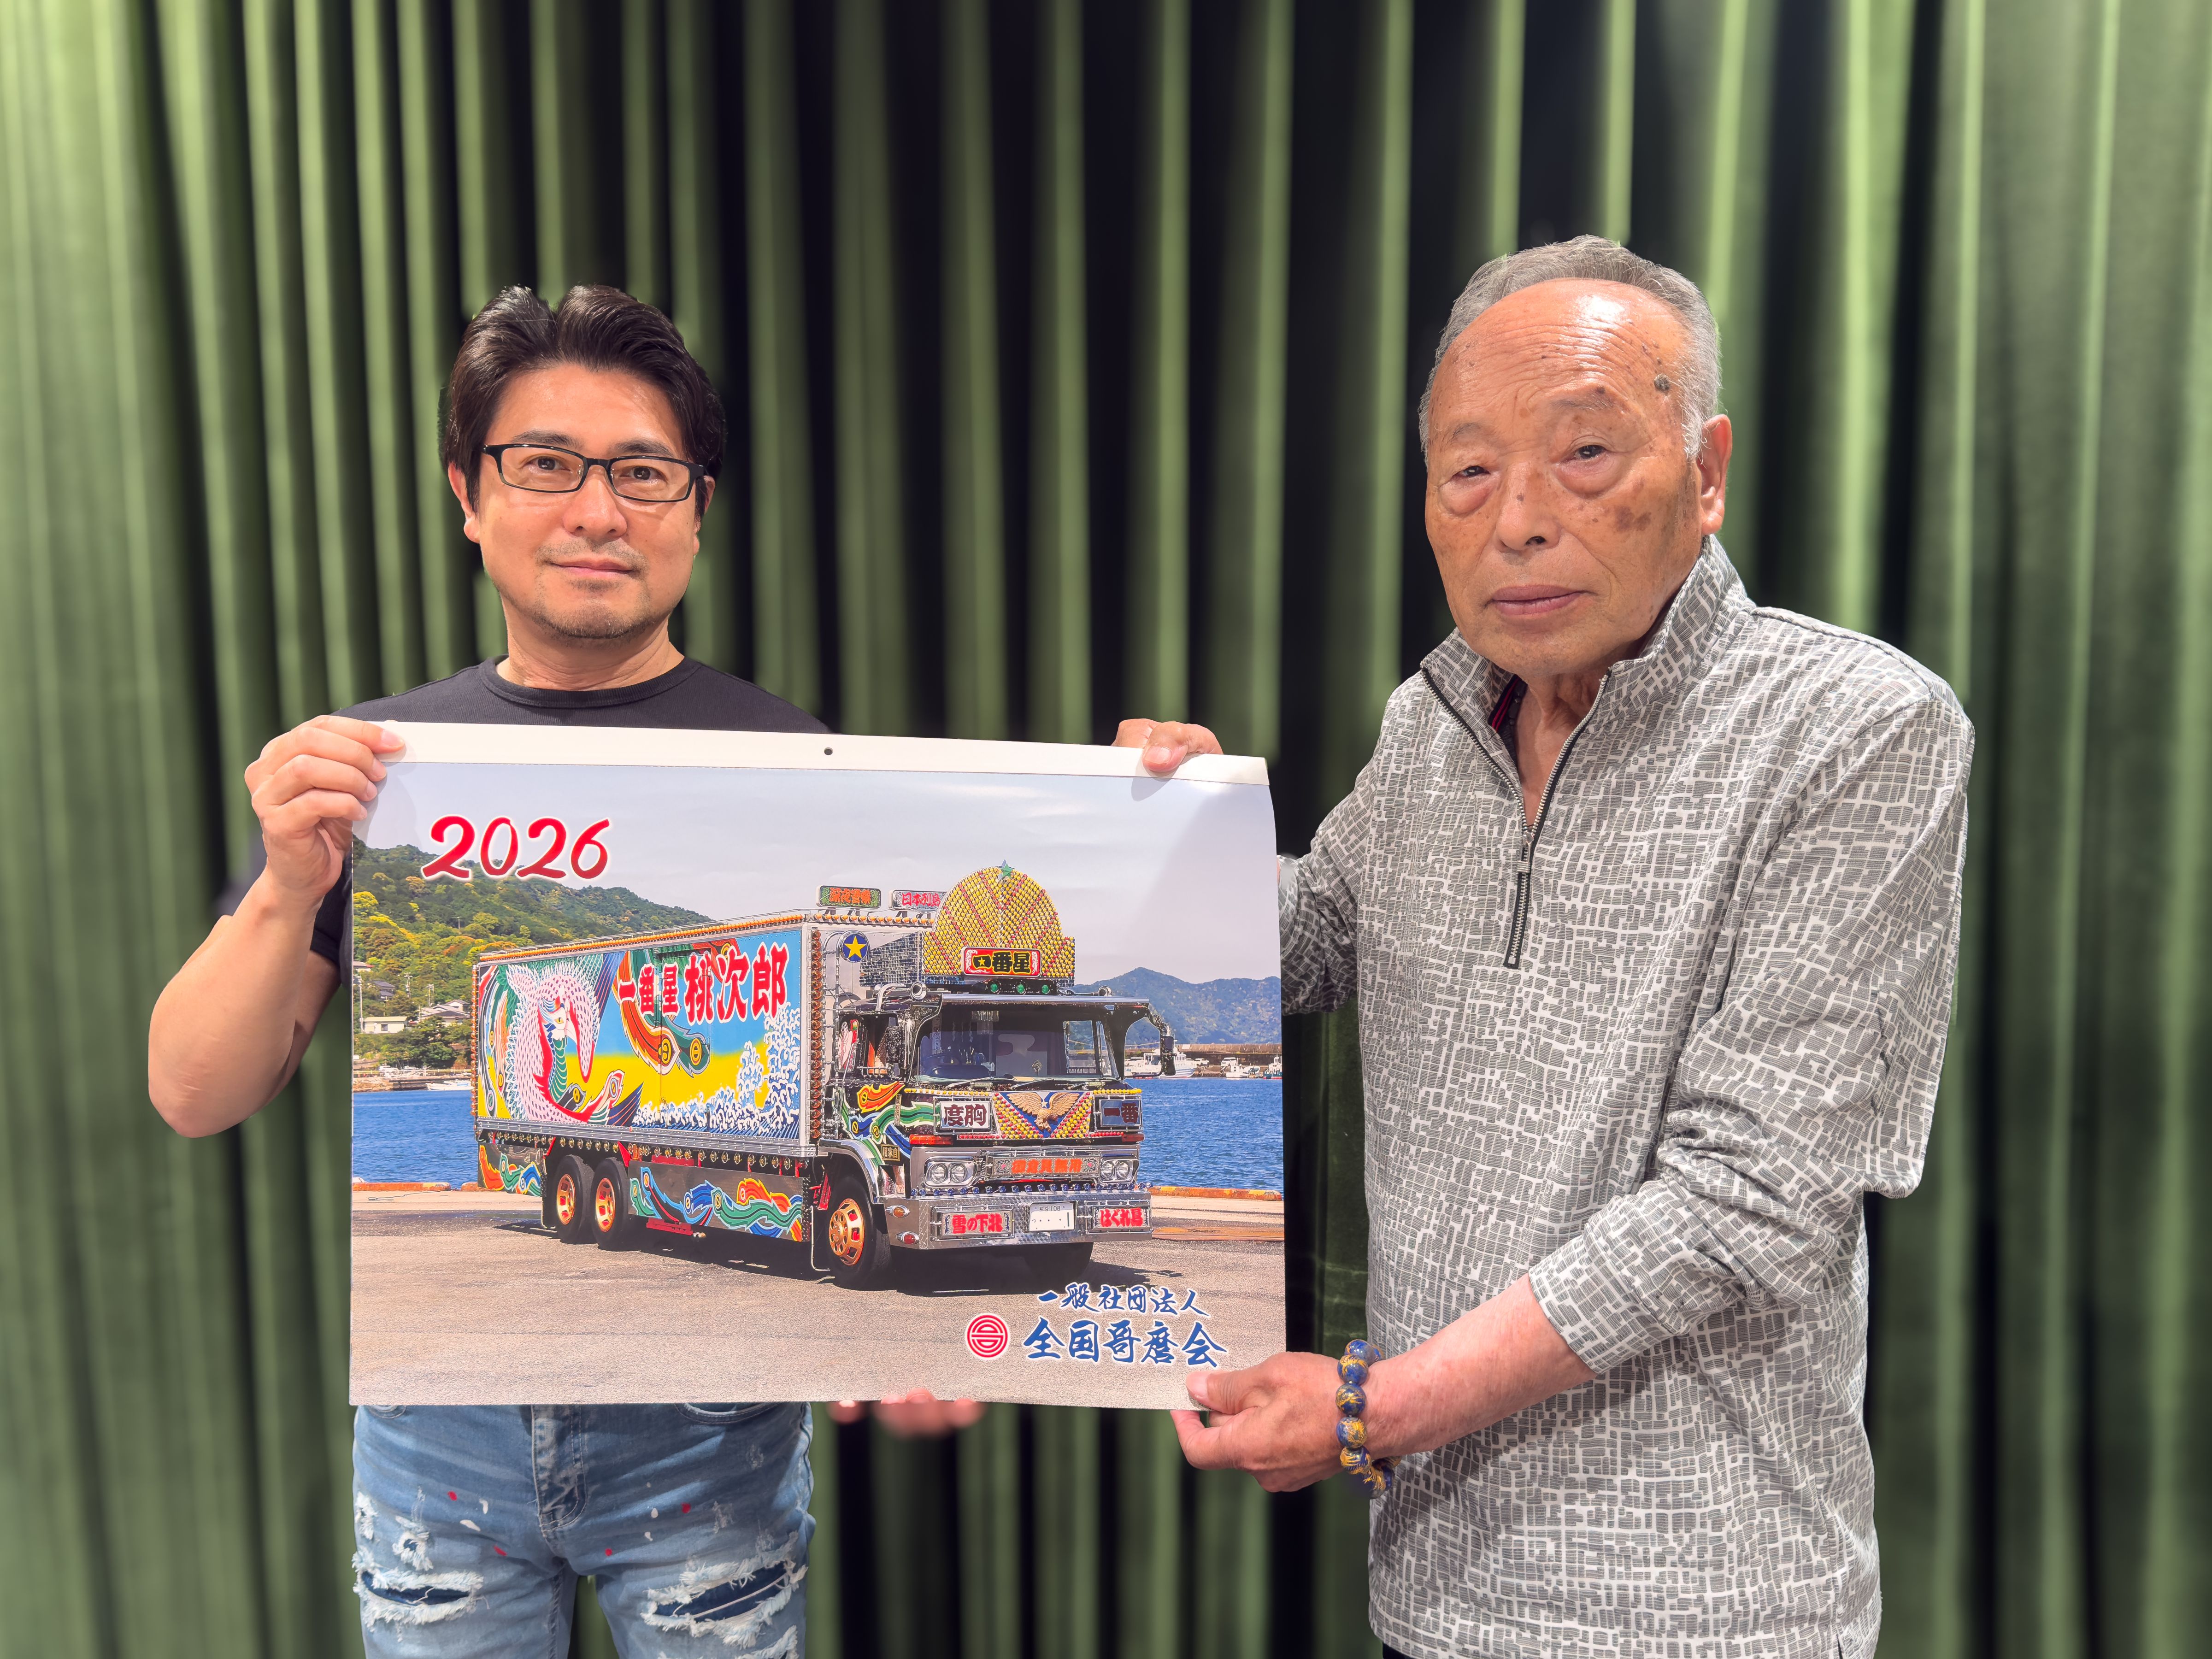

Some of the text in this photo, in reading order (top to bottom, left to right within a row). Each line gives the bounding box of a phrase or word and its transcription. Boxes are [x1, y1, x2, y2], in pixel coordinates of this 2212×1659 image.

[422, 815, 610, 879] 2026
[902, 892, 941, 906] 日本列島
[944, 1104, 987, 1126] 度胸
[1103, 1102, 1139, 1124] 一番
[952, 1213, 1003, 1234] 雪の下北
[1038, 1283, 1210, 1317] 一般社団法人
[1023, 1317, 1227, 1367] 全国哥麿会
